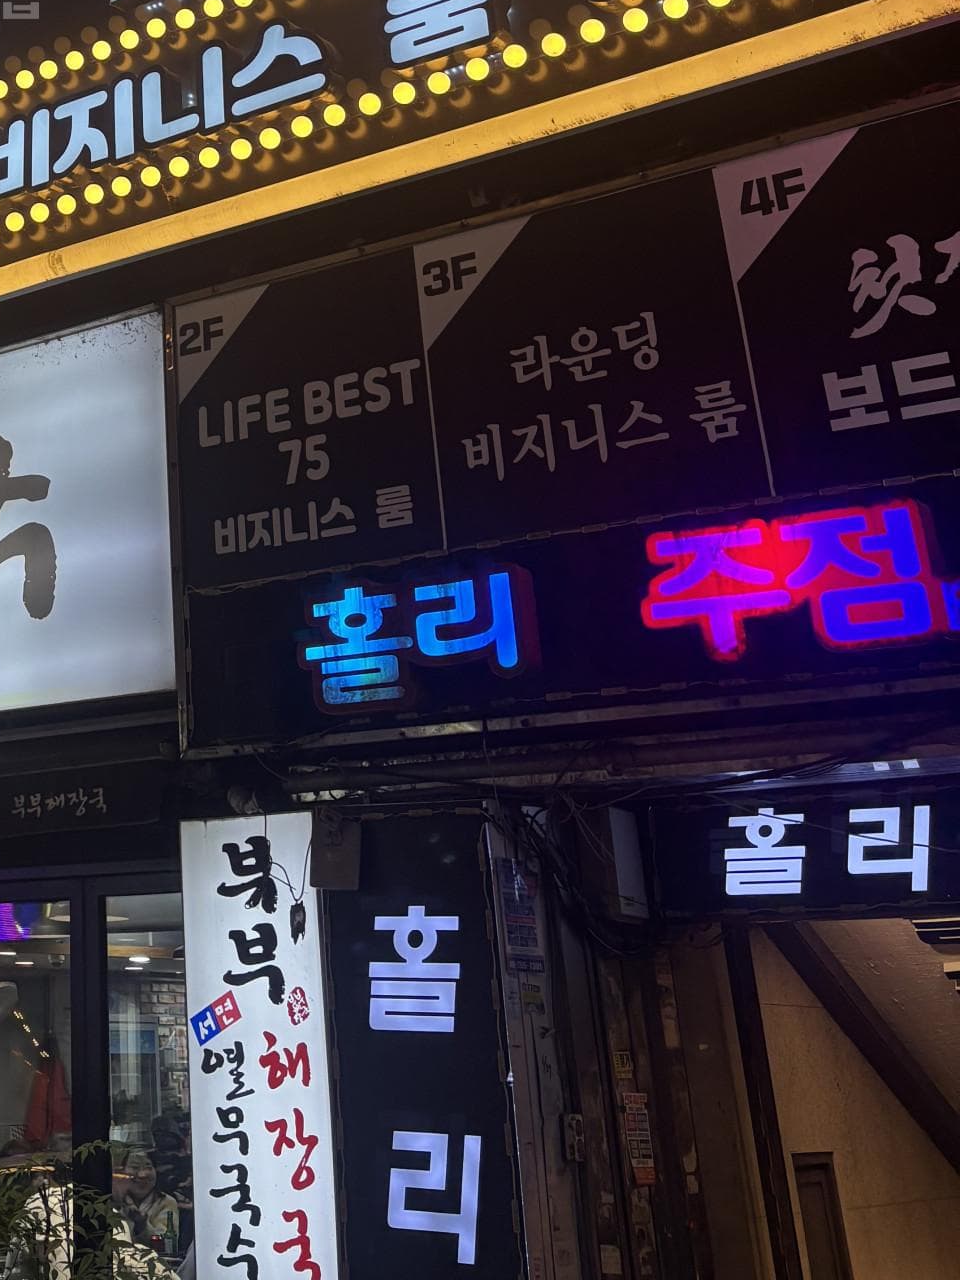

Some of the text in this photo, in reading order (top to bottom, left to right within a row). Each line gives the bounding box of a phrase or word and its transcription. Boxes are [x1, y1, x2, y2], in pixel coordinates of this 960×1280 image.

[740, 167, 805, 216] 4F
[423, 251, 478, 297] 3F
[178, 316, 226, 357] 2F
[510, 312, 660, 391] 라운딩
[198, 358, 422, 448] LIFE BEST
[462, 379, 748, 482] 비지니스 룸
[822, 351, 960, 432] 보드
[278, 434, 331, 486] 75
[214, 484, 415, 556] 비지니스 룸
[305, 506, 932, 706] 홀리 주점
[11, 786, 108, 818] 부부해장국
[724, 806, 931, 896] 홀리
[217, 835, 286, 1005] 부부
[196, 998, 236, 1043] 서면
[369, 906, 481, 1266] 홀리
[201, 1040, 261, 1280] 열무국수
[259, 1031, 321, 1280] 해장국
